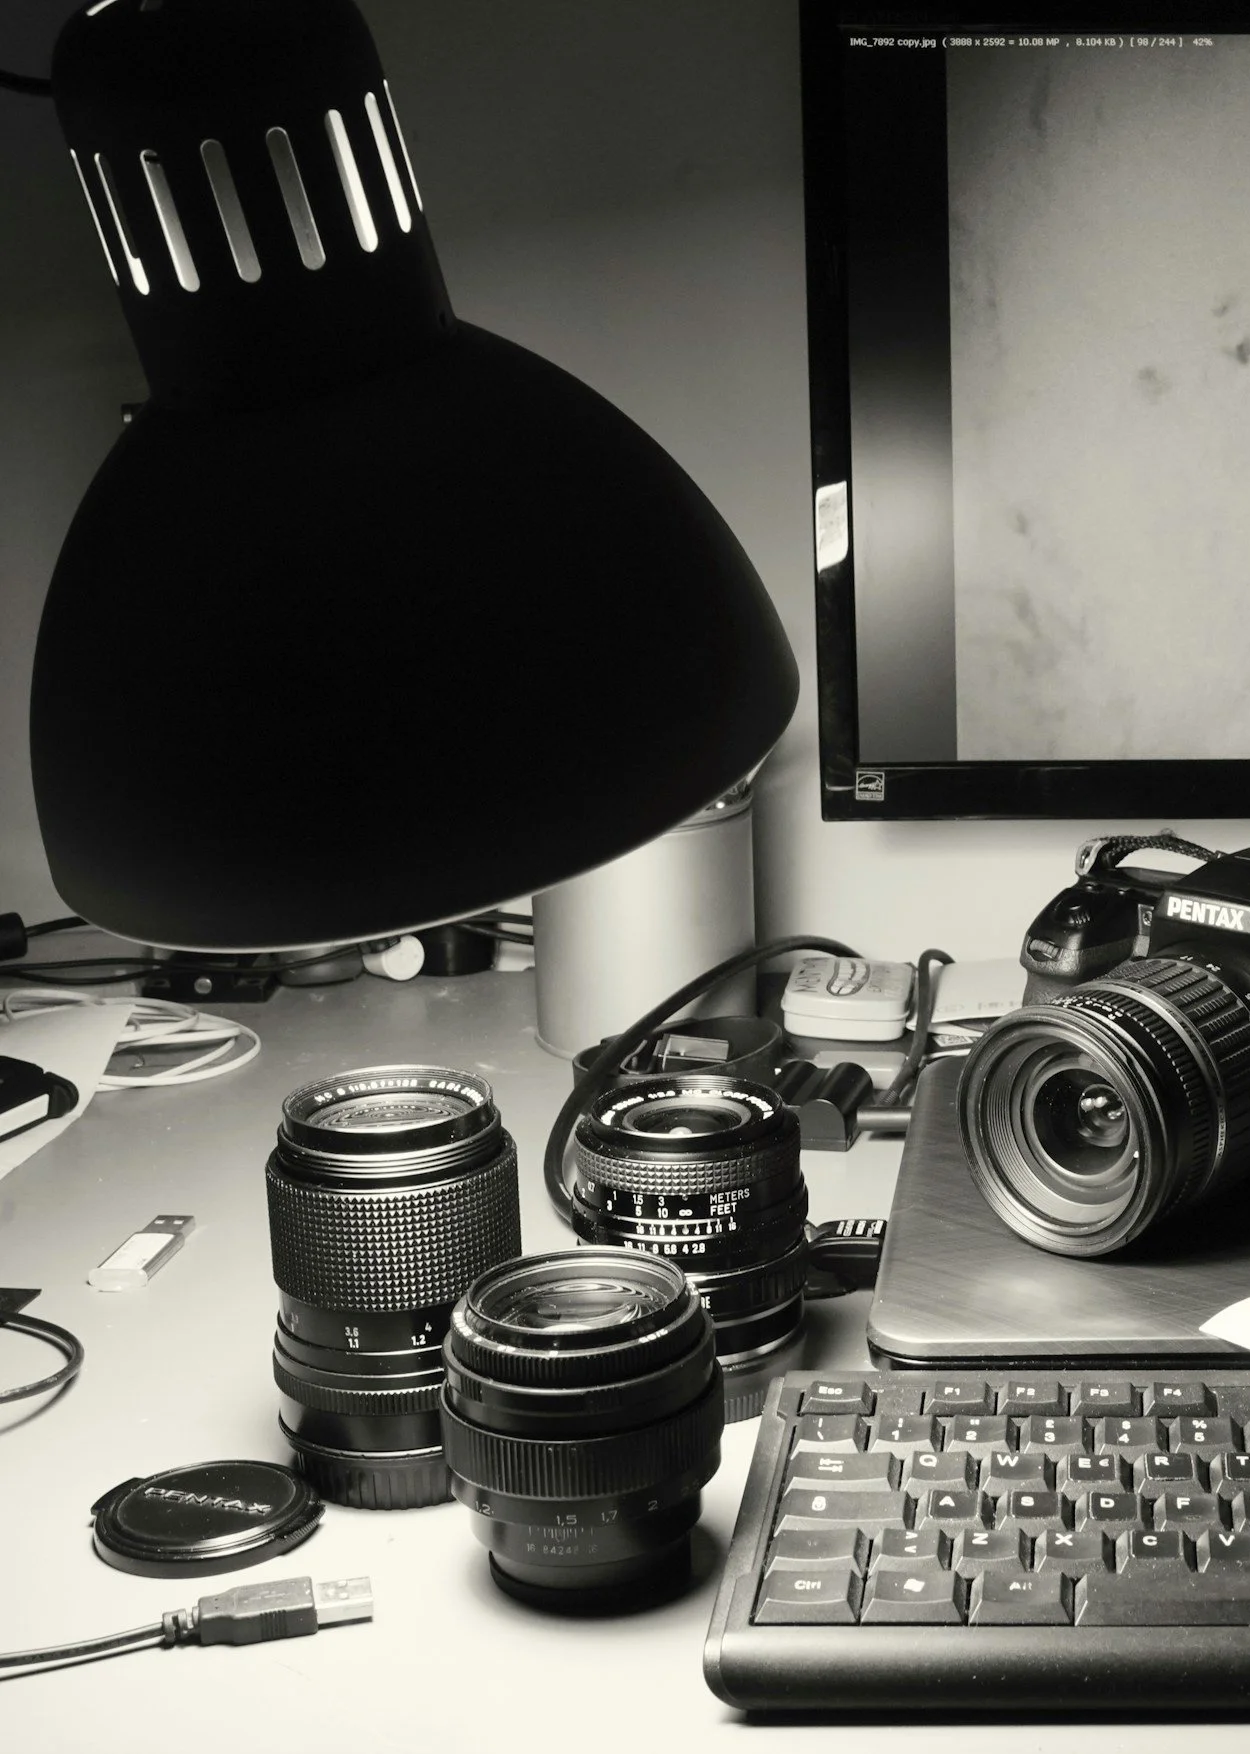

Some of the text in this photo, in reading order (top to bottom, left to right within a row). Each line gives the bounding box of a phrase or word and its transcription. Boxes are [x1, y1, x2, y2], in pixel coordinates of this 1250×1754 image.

[850, 37, 894, 48] IMG_7892
[897, 38, 936, 48] copy.jpg
[983, 38, 1005, 46] 2592
[1046, 38, 1060, 46] MP
[1076, 38, 1101, 46] 8.104
[1159, 38, 1176, 46] 244
[1193, 38, 1213, 46] 42%
[1167, 896, 1244, 931] PENTAX
[613, 1190, 617, 1201] 1
[658, 1196, 665, 1207] 3
[709, 1188, 750, 1204] METERS
[607, 1200, 613, 1211] 3
[635, 1205, 642, 1217] 5
[657, 1207, 669, 1218] 10
[710, 1202, 738, 1216] FEET
[652, 1243, 659, 1254] 8
[682, 1243, 689, 1254] 4
[692, 1242, 706, 1254] 2.8
[345, 1326, 359, 1337] 3.6
[425, 1322, 432, 1333] 4
[348, 1335, 426, 1349] 1.1 1.2
[818, 1386, 843, 1395] Esc
[944, 1387, 961, 1396] F1
[1015, 1386, 1036, 1396] F2
[1089, 1388, 1109, 1397] F3
[1163, 1387, 1182, 1397] F4
[891, 1430, 899, 1441] 1
[966, 1430, 977, 1441] 2
[1044, 1432, 1056, 1443] 3
[1118, 1433, 1130, 1444] 4
[1194, 1433, 1205, 1443] 5
[918, 1454, 938, 1468] Q
[996, 1456, 1019, 1467] W
[1079, 1457, 1091, 1469] E
[1155, 1456, 1170, 1467] R
[1236, 1456, 1249, 1466] T
[144, 1487, 272, 1516] PENTAX
[647, 1500, 659, 1512] 2
[938, 1495, 956, 1507] A
[1020, 1496, 1035, 1507] S
[1099, 1497, 1115, 1508] D
[1176, 1497, 1191, 1510] F
[971, 1532, 989, 1545] Z
[1054, 1533, 1074, 1547] X
[1142, 1535, 1158, 1547] C
[1218, 1534, 1236, 1547] V
[794, 1580, 822, 1591] Ctrl
